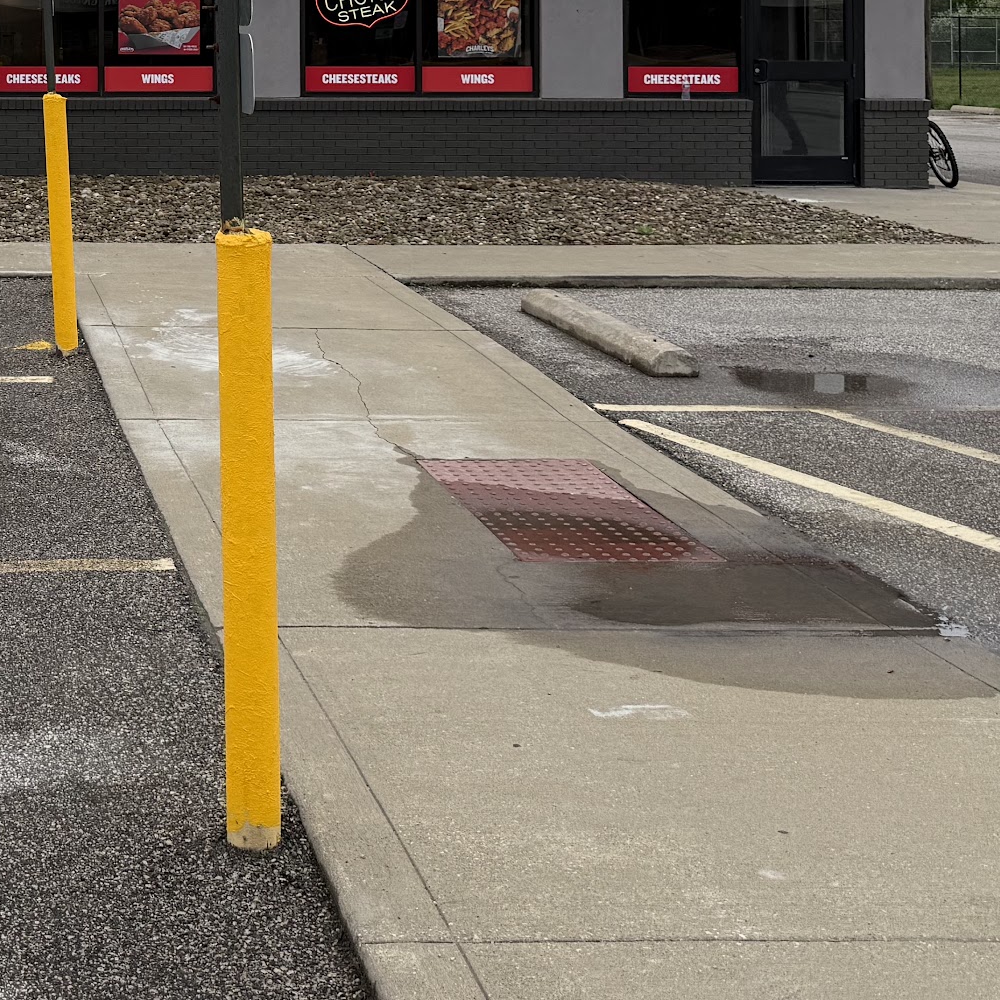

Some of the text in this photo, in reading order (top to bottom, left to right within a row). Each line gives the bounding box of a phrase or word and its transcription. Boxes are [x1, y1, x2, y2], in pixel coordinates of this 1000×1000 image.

[337, 0, 398, 22] STEAK
[6, 73, 81, 84] CHEESESEAKS
[141, 73, 175, 84] WINGS
[322, 74, 398, 84] CHEESESTEAKS
[460, 74, 495, 84] WINGS
[643, 73, 721, 85] CHEESESTEAKS
